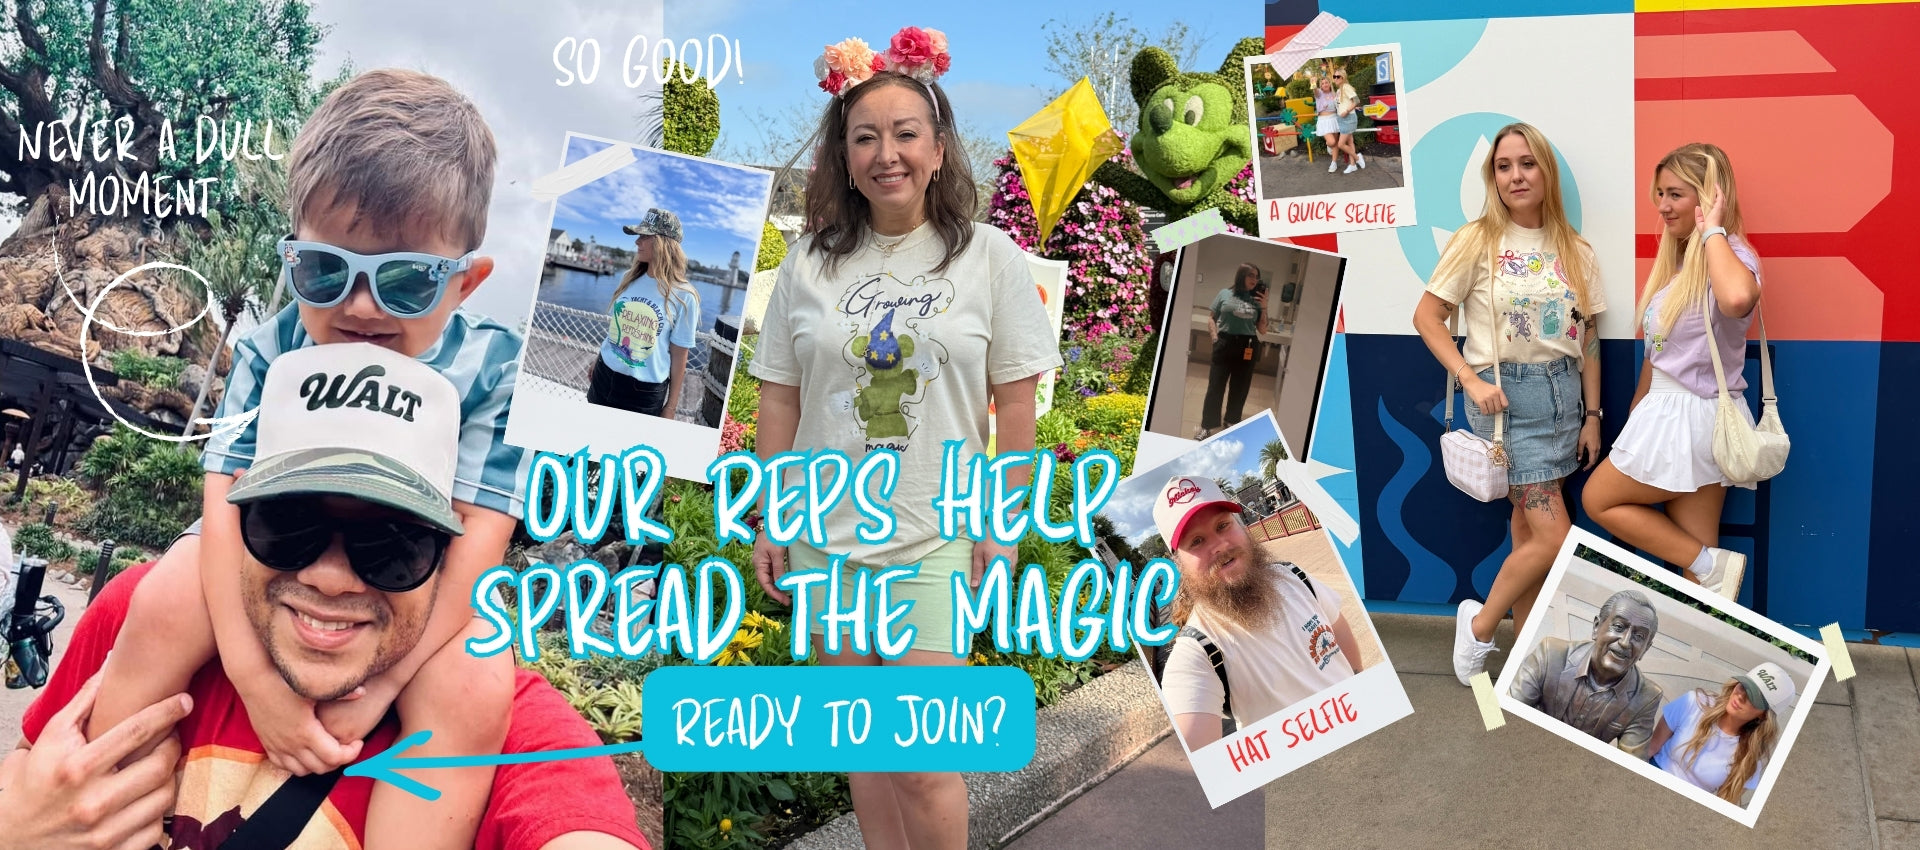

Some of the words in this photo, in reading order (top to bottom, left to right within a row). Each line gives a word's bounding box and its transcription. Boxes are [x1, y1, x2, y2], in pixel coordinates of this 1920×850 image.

[845, 277, 942, 318] Growing
[622, 309, 658, 331] RELAXING
[299, 364, 422, 422] WALT
[1756, 669, 1778, 692] WALT
